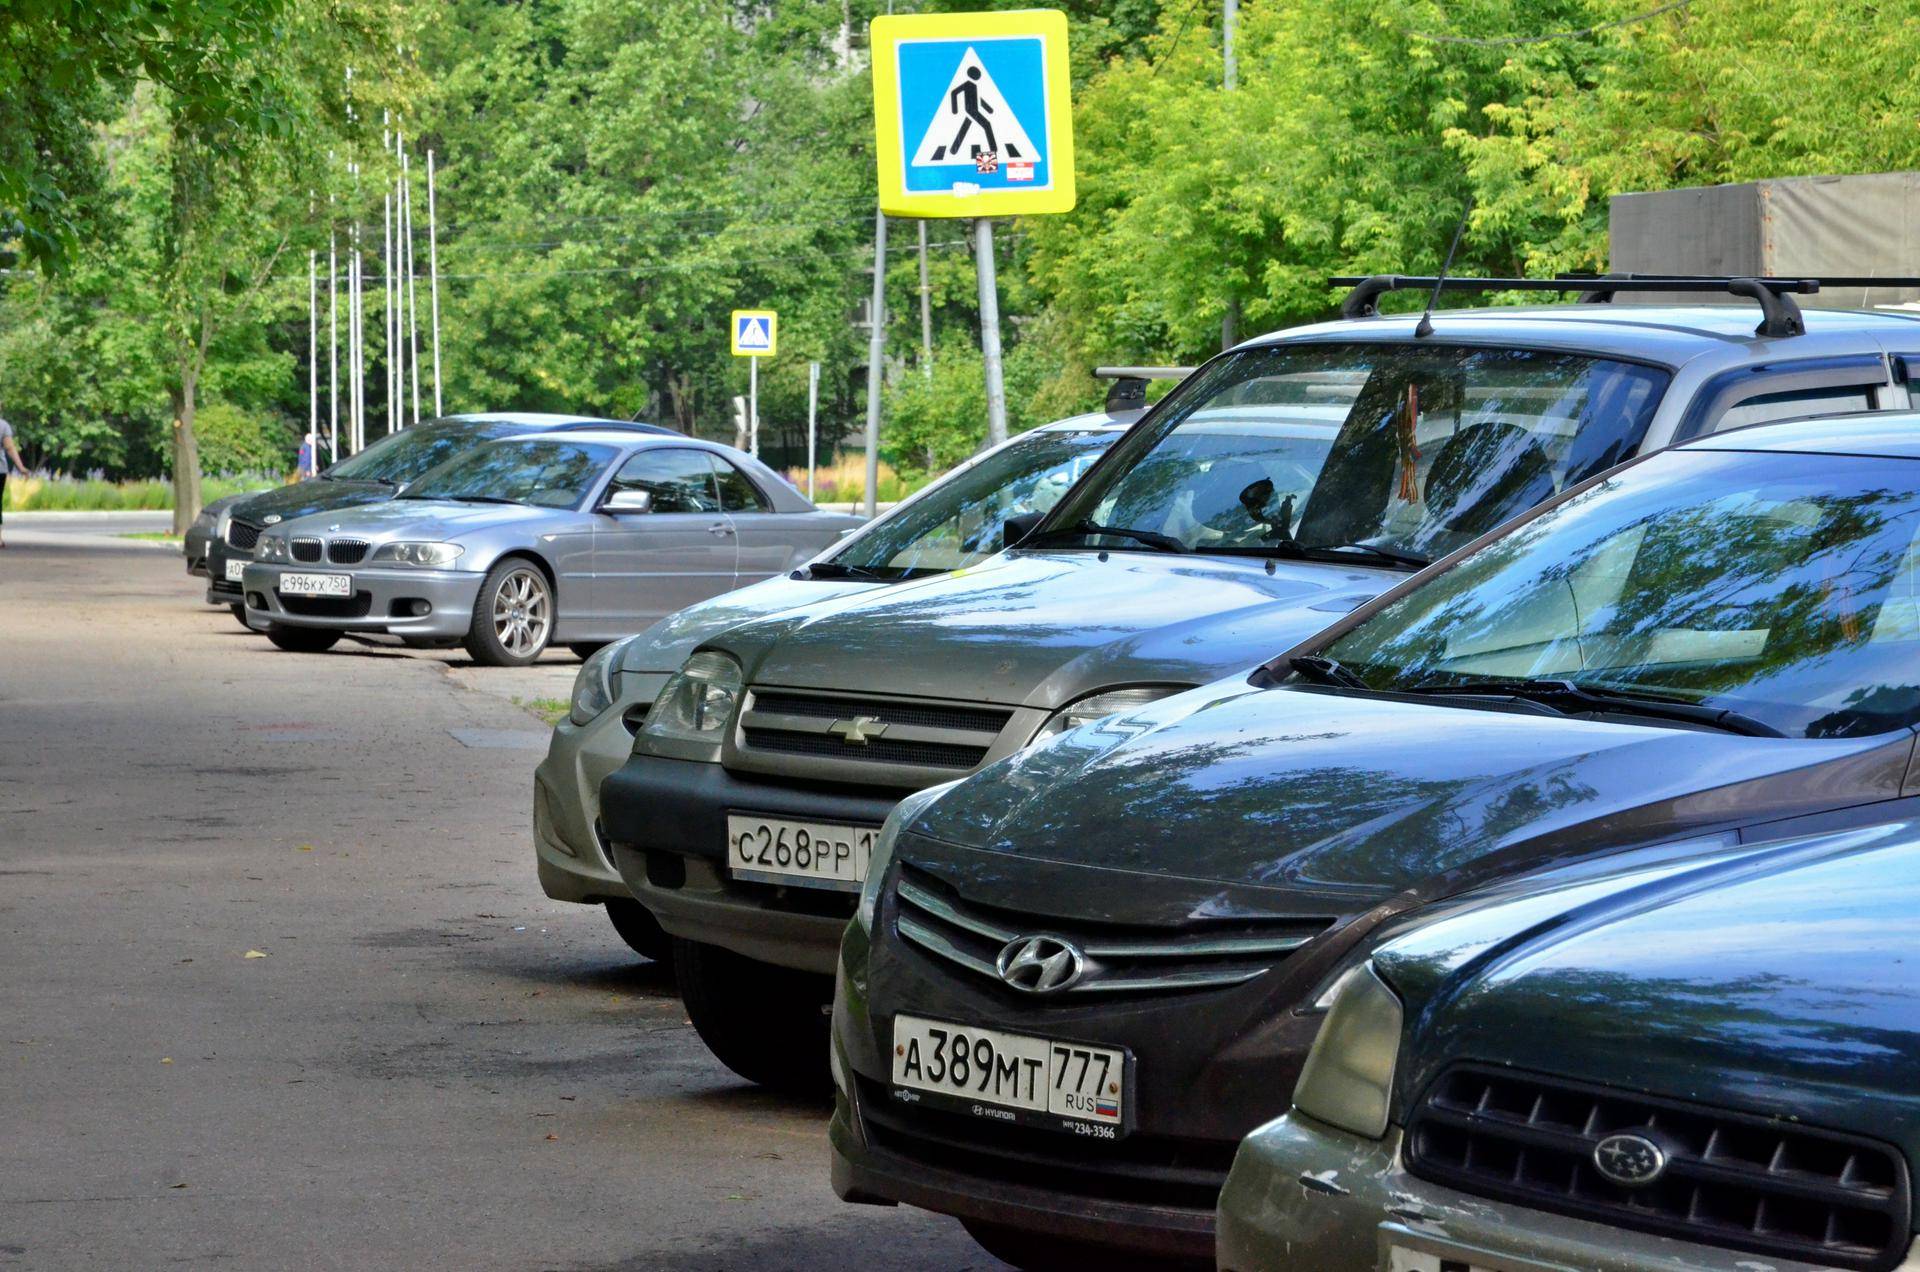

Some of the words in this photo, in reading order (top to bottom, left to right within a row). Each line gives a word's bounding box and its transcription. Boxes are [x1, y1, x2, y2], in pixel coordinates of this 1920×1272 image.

[328, 576, 347, 588] 750
[738, 824, 850, 874] С268РР
[859, 832, 880, 859] 1
[903, 1028, 1044, 1101] А389МТ
[1053, 1046, 1112, 1097] 777
[1065, 1093, 1095, 1113] RUS
[984, 1108, 1016, 1121] HYUNDAI
[1074, 1122, 1116, 1140] 234-3366
